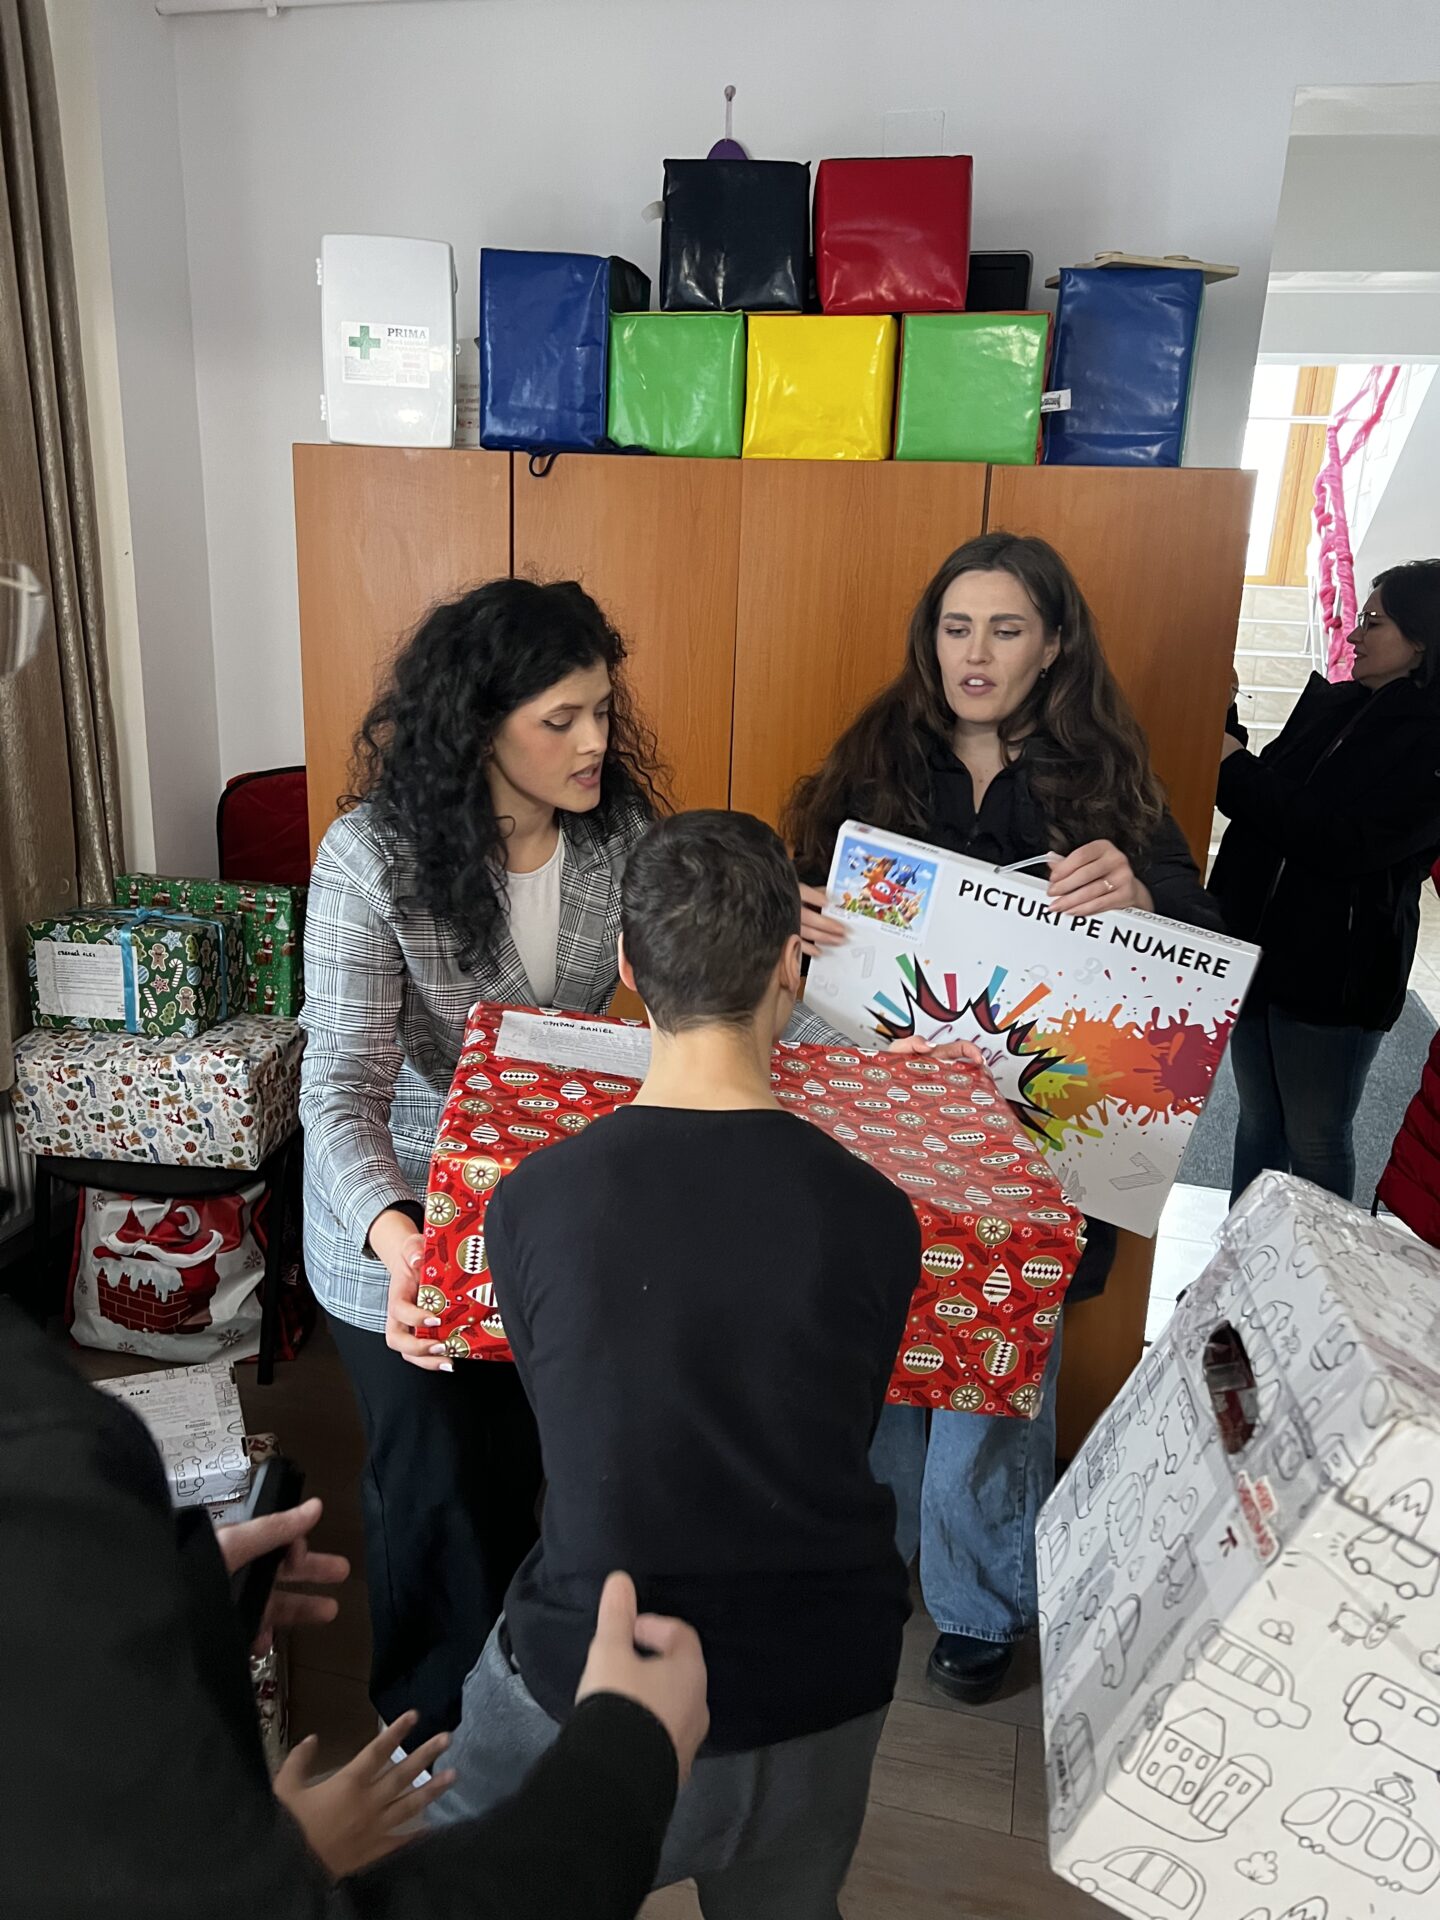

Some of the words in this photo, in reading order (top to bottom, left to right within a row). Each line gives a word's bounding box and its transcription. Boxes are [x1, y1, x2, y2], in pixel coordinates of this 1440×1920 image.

[387, 327, 427, 340] PRIMA
[958, 878, 1063, 927] PICTURI
[1069, 914, 1104, 939] PE
[1110, 925, 1231, 979] NUMERE
[580, 1025, 614, 1034] DANIEL
